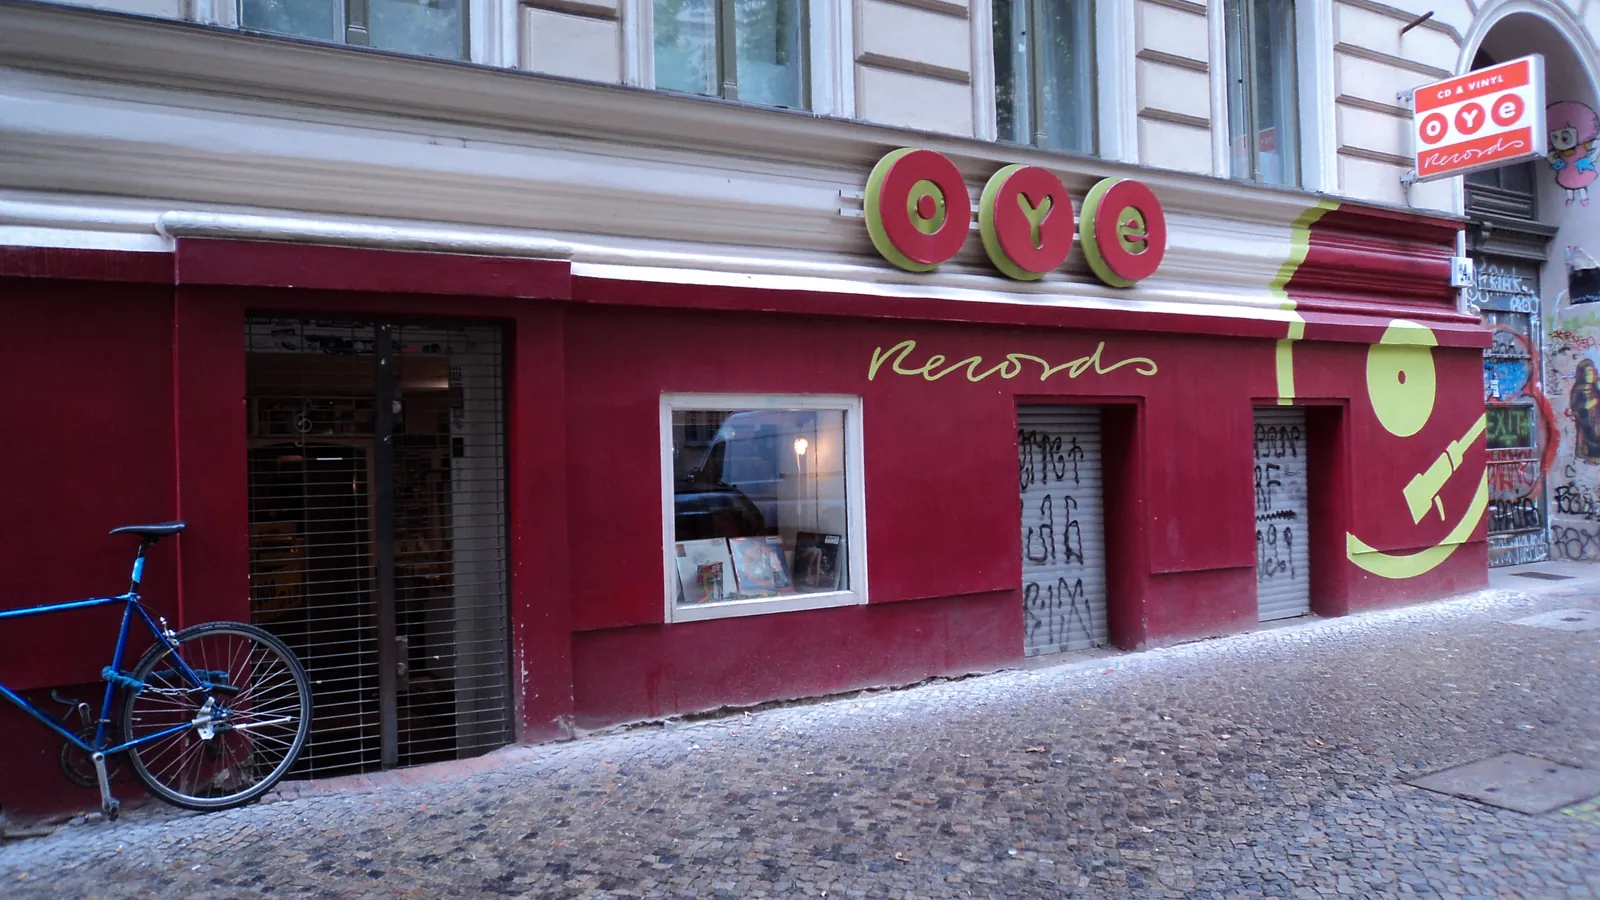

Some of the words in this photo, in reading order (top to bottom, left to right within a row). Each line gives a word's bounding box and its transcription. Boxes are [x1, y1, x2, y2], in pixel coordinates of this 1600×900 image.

[1437, 89, 1451, 99] CD
[1456, 85, 1464, 94] &
[1468, 75, 1504, 90] VINYL
[868, 339, 1159, 382] Records
